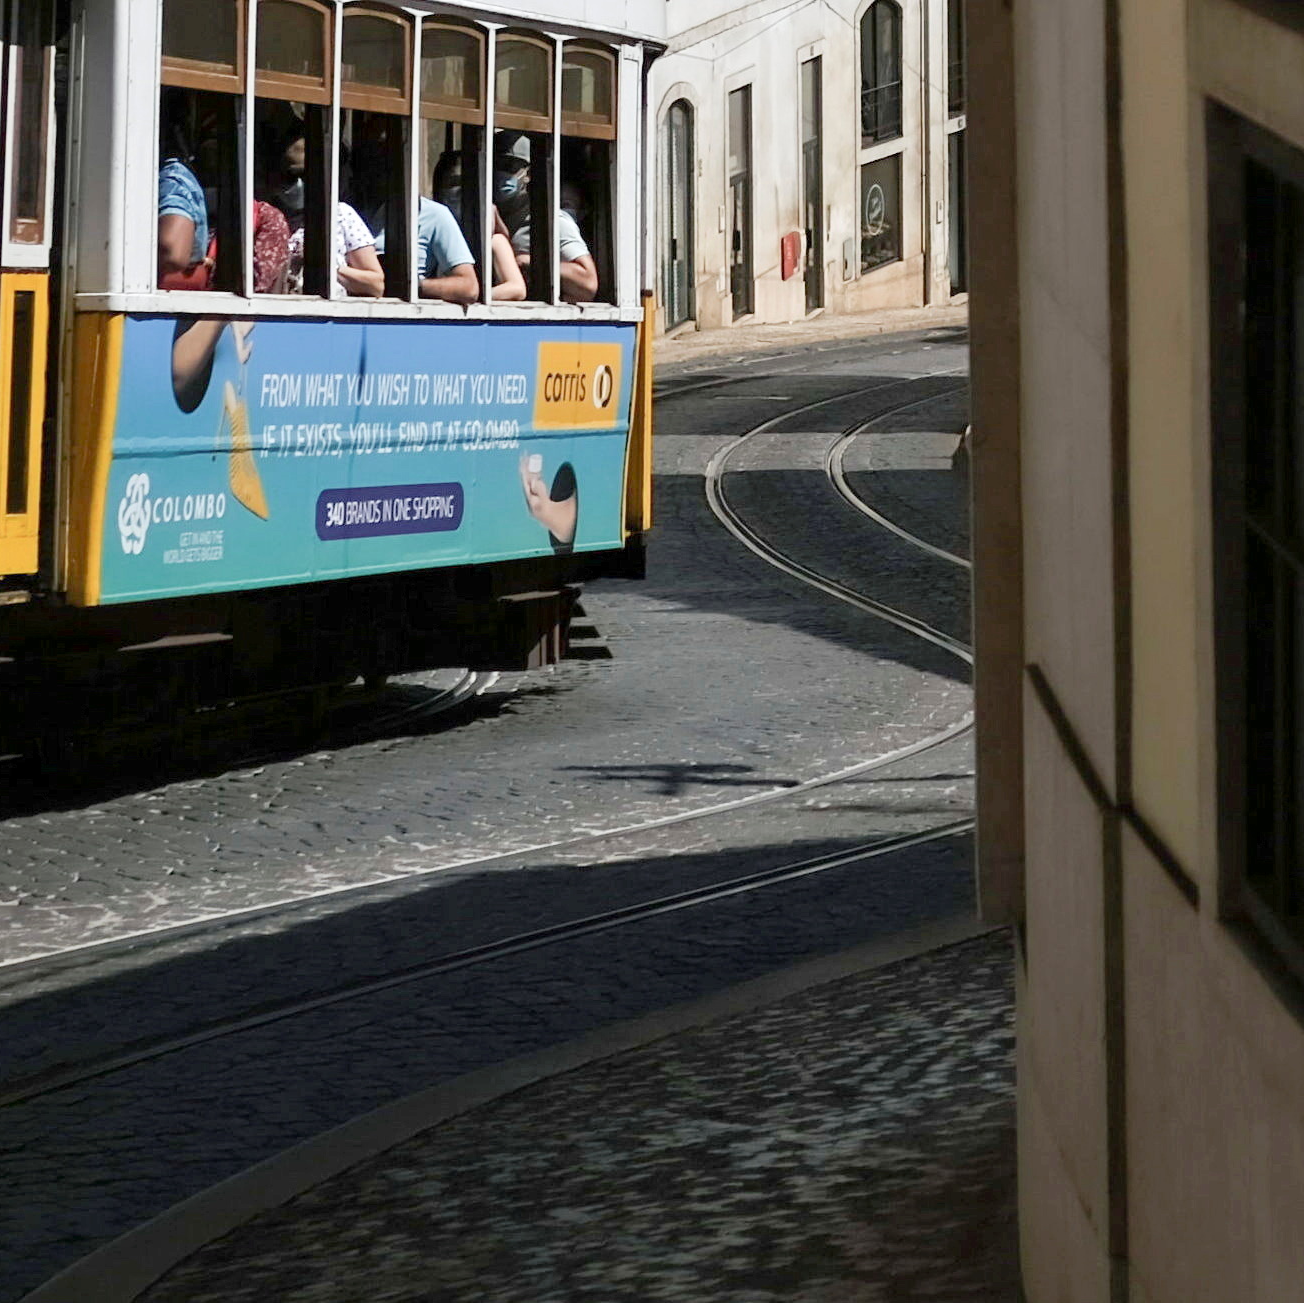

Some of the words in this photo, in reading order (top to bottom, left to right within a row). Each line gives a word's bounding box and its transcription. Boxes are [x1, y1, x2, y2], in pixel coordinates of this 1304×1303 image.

[260, 373, 301, 408] FROM
[305, 373, 343, 407] WHAT
[346, 373, 375, 406] YOU
[377, 373, 410, 406] WISH
[414, 373, 430, 405] TO
[433, 373, 467, 405] WHAT
[470, 373, 495, 405] YOU
[496, 373, 528, 405] NEED.
[260, 424, 276, 457] IF
[278, 424, 294, 457] IT
[396, 421, 428, 453] FIND
[429, 420, 444, 451] IT
[443, 419, 461, 451] AT
[153, 493, 226, 523] COLOMBO
[326, 502, 345, 527] 340
[346, 500, 382, 525] BRANDS
[382, 499, 393, 522] IN
[393, 498, 411, 521] ONE
[412, 495, 454, 520] SHOPPING
